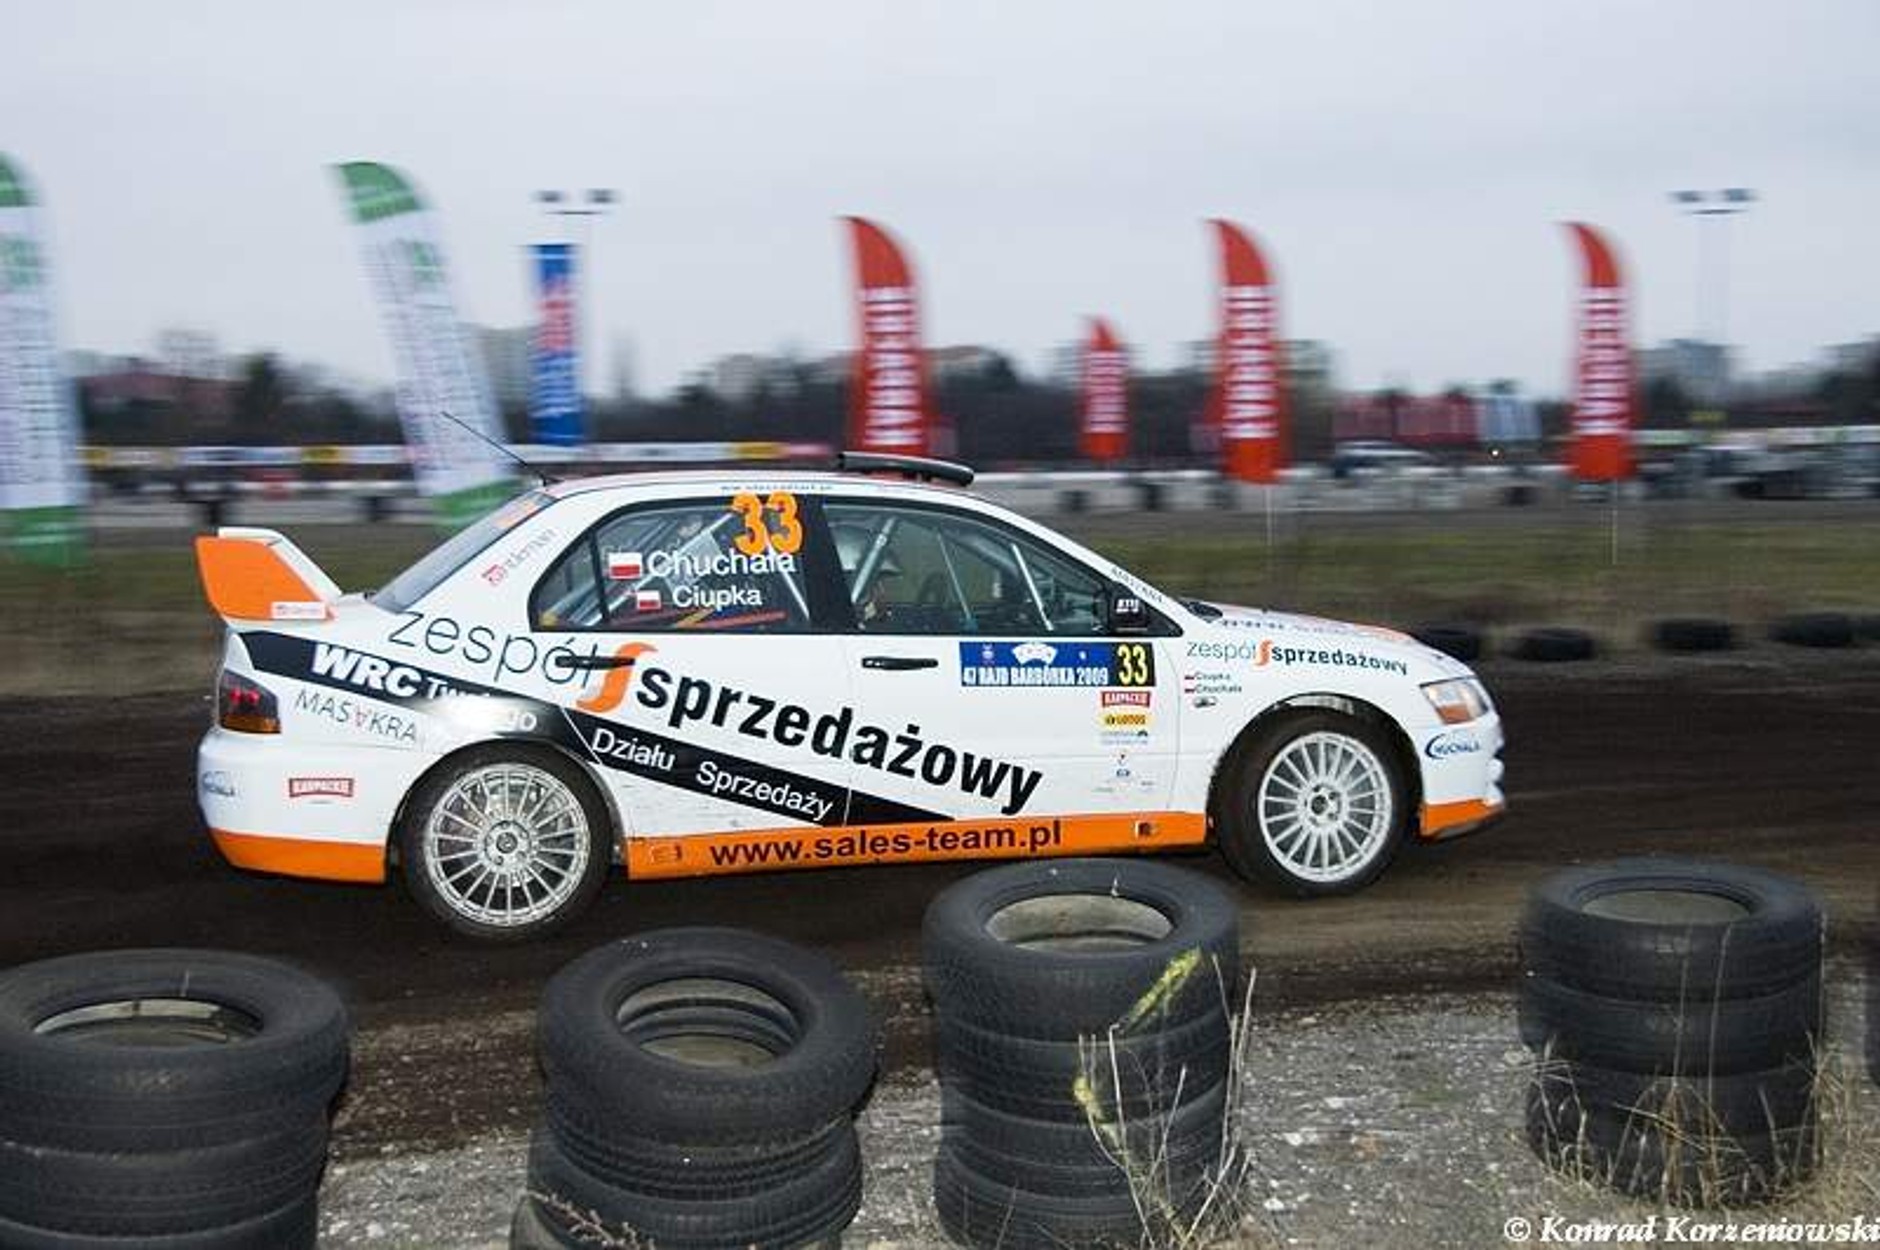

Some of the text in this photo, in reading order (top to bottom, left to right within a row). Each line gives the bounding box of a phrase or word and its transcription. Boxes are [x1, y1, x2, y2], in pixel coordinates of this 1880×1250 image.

[732, 491, 803, 555] 33
[672, 585, 762, 612] Ciupka
[978, 668, 1009, 685] RAJD
[1077, 668, 1109, 685] 2009
[1117, 644, 1148, 685] 33
[1271, 646, 1407, 675] sprzedażowy
[311, 642, 422, 697] WRC
[592, 728, 676, 771] Działu
[696, 761, 833, 821] Sprzedaży
[636, 665, 1043, 816] sprzedażowy
[709, 820, 1062, 866] www.sales-team.pl
